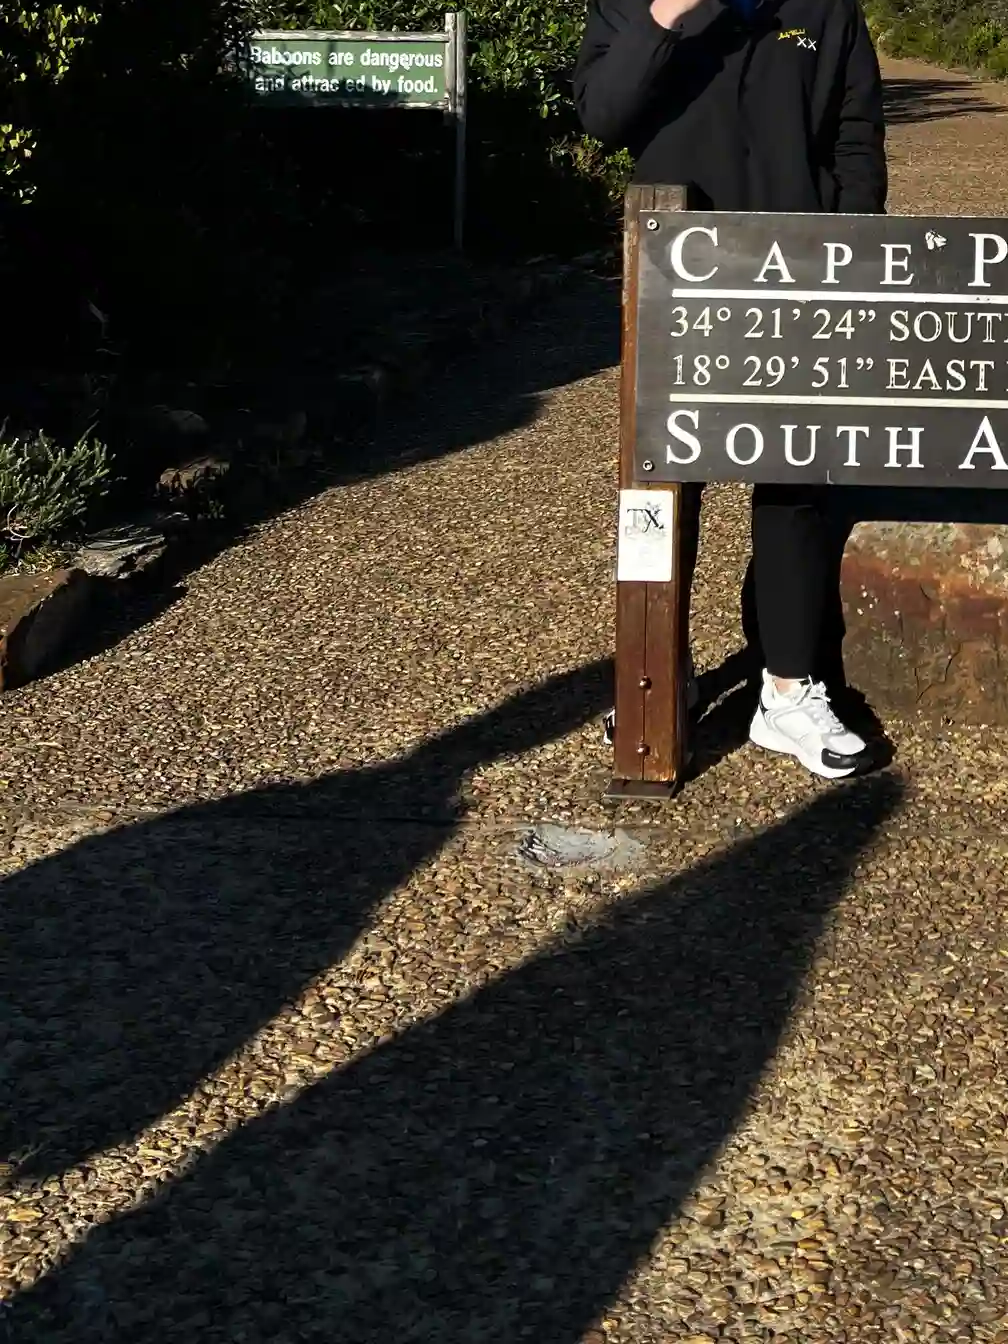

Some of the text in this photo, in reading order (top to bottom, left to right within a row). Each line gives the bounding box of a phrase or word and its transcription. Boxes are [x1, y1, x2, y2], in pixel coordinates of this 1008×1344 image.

[250, 46, 443, 72] Baboons are dangerous
[255, 76, 438, 94] and attraced by food.
[670, 226, 914, 285] CAPE
[670, 306, 731, 338] 34°
[672, 354, 730, 386] 18°
[886, 359, 995, 392] EAST
[666, 409, 924, 468] SOUTH
